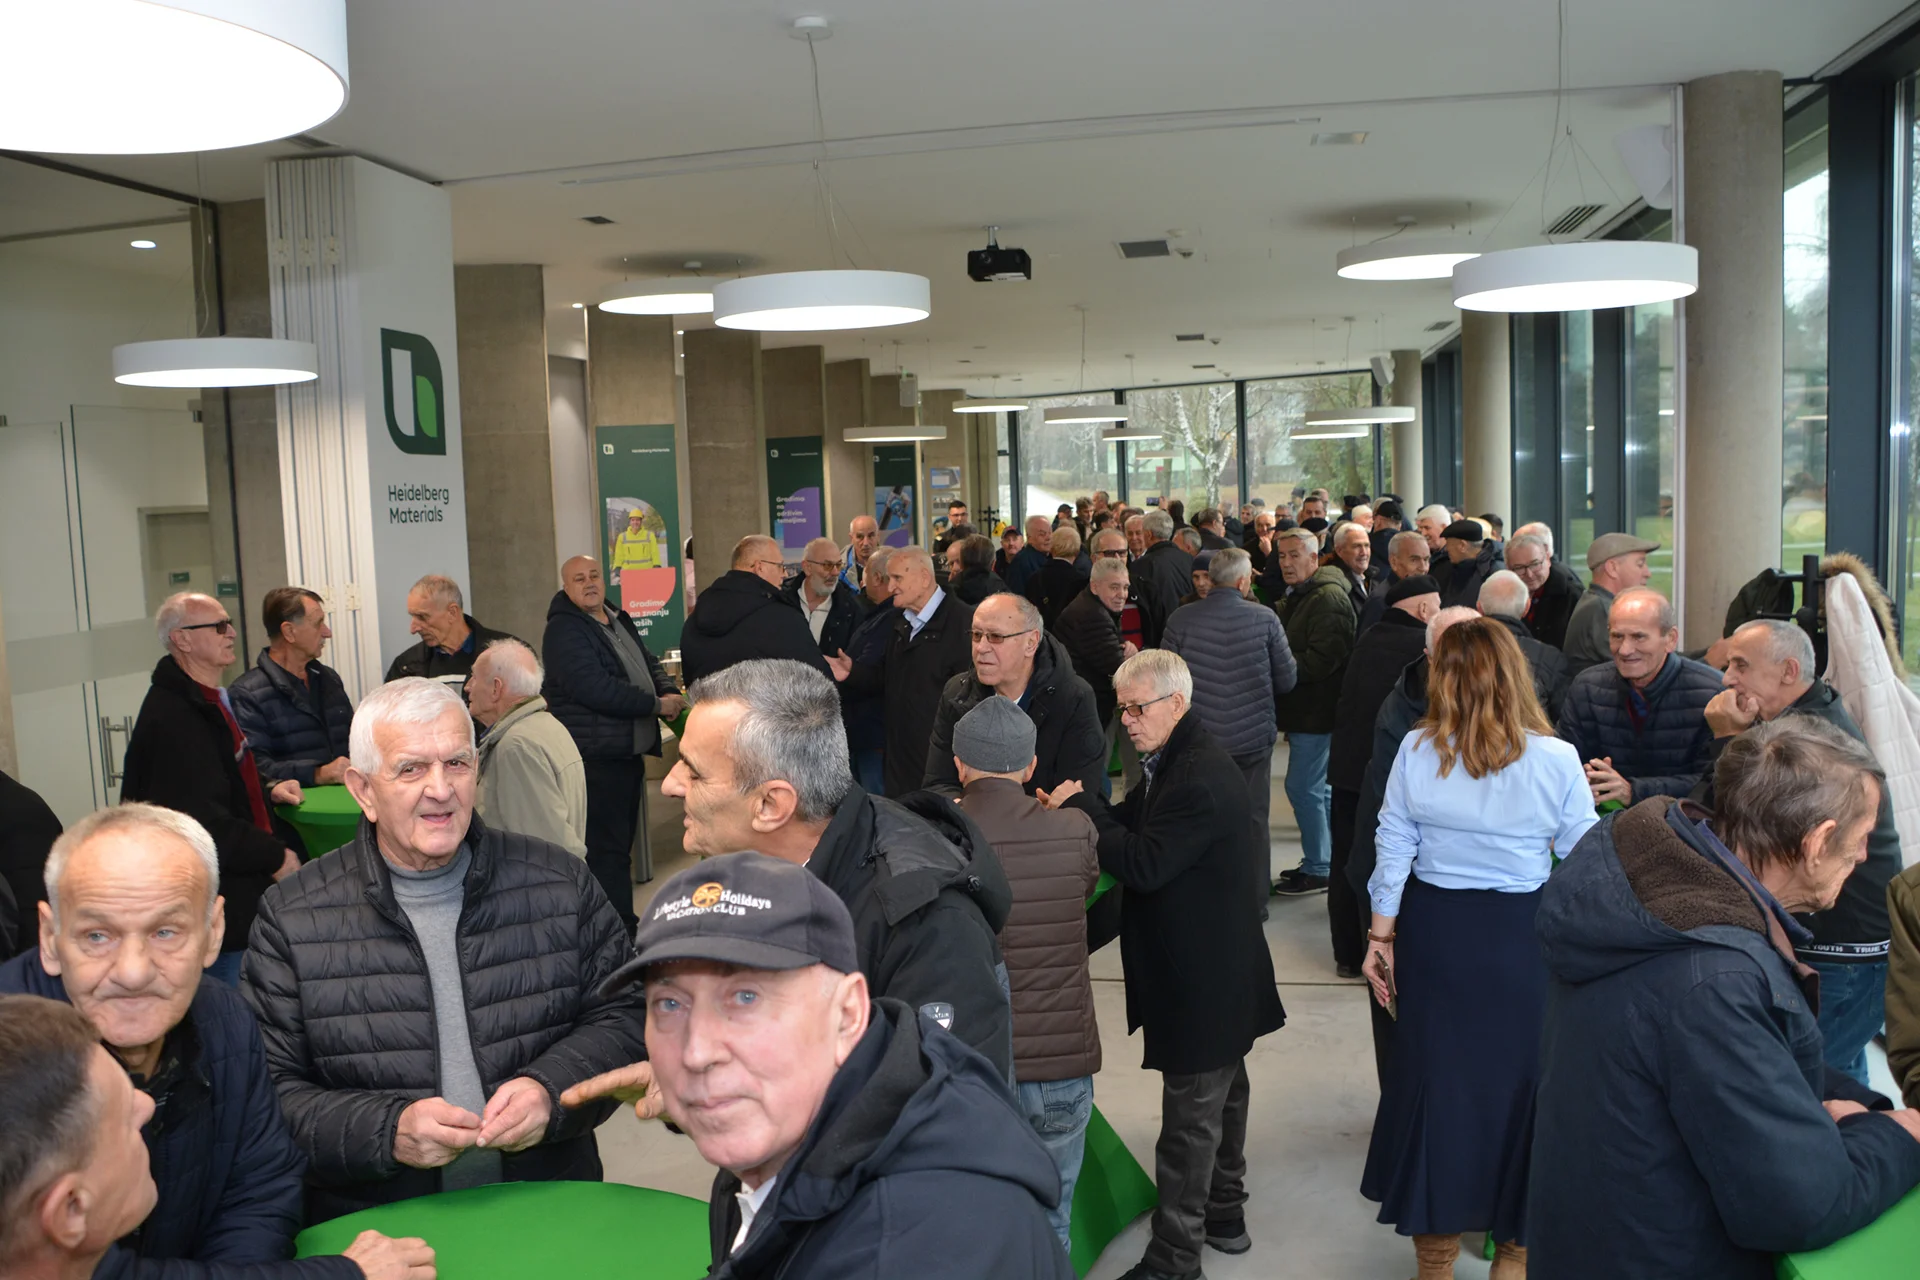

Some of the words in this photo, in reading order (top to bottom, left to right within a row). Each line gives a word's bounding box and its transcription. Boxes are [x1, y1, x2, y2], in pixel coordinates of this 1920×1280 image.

[388, 483, 449, 505] Heidelberg
[389, 505, 443, 524] Materials
[629, 600, 665, 608] Gradimo
[642, 608, 669, 617] znanju
[720, 890, 772, 909] Holidays
[713, 903, 746, 916] CLUB
[1813, 944, 1843, 952] YOUTH
